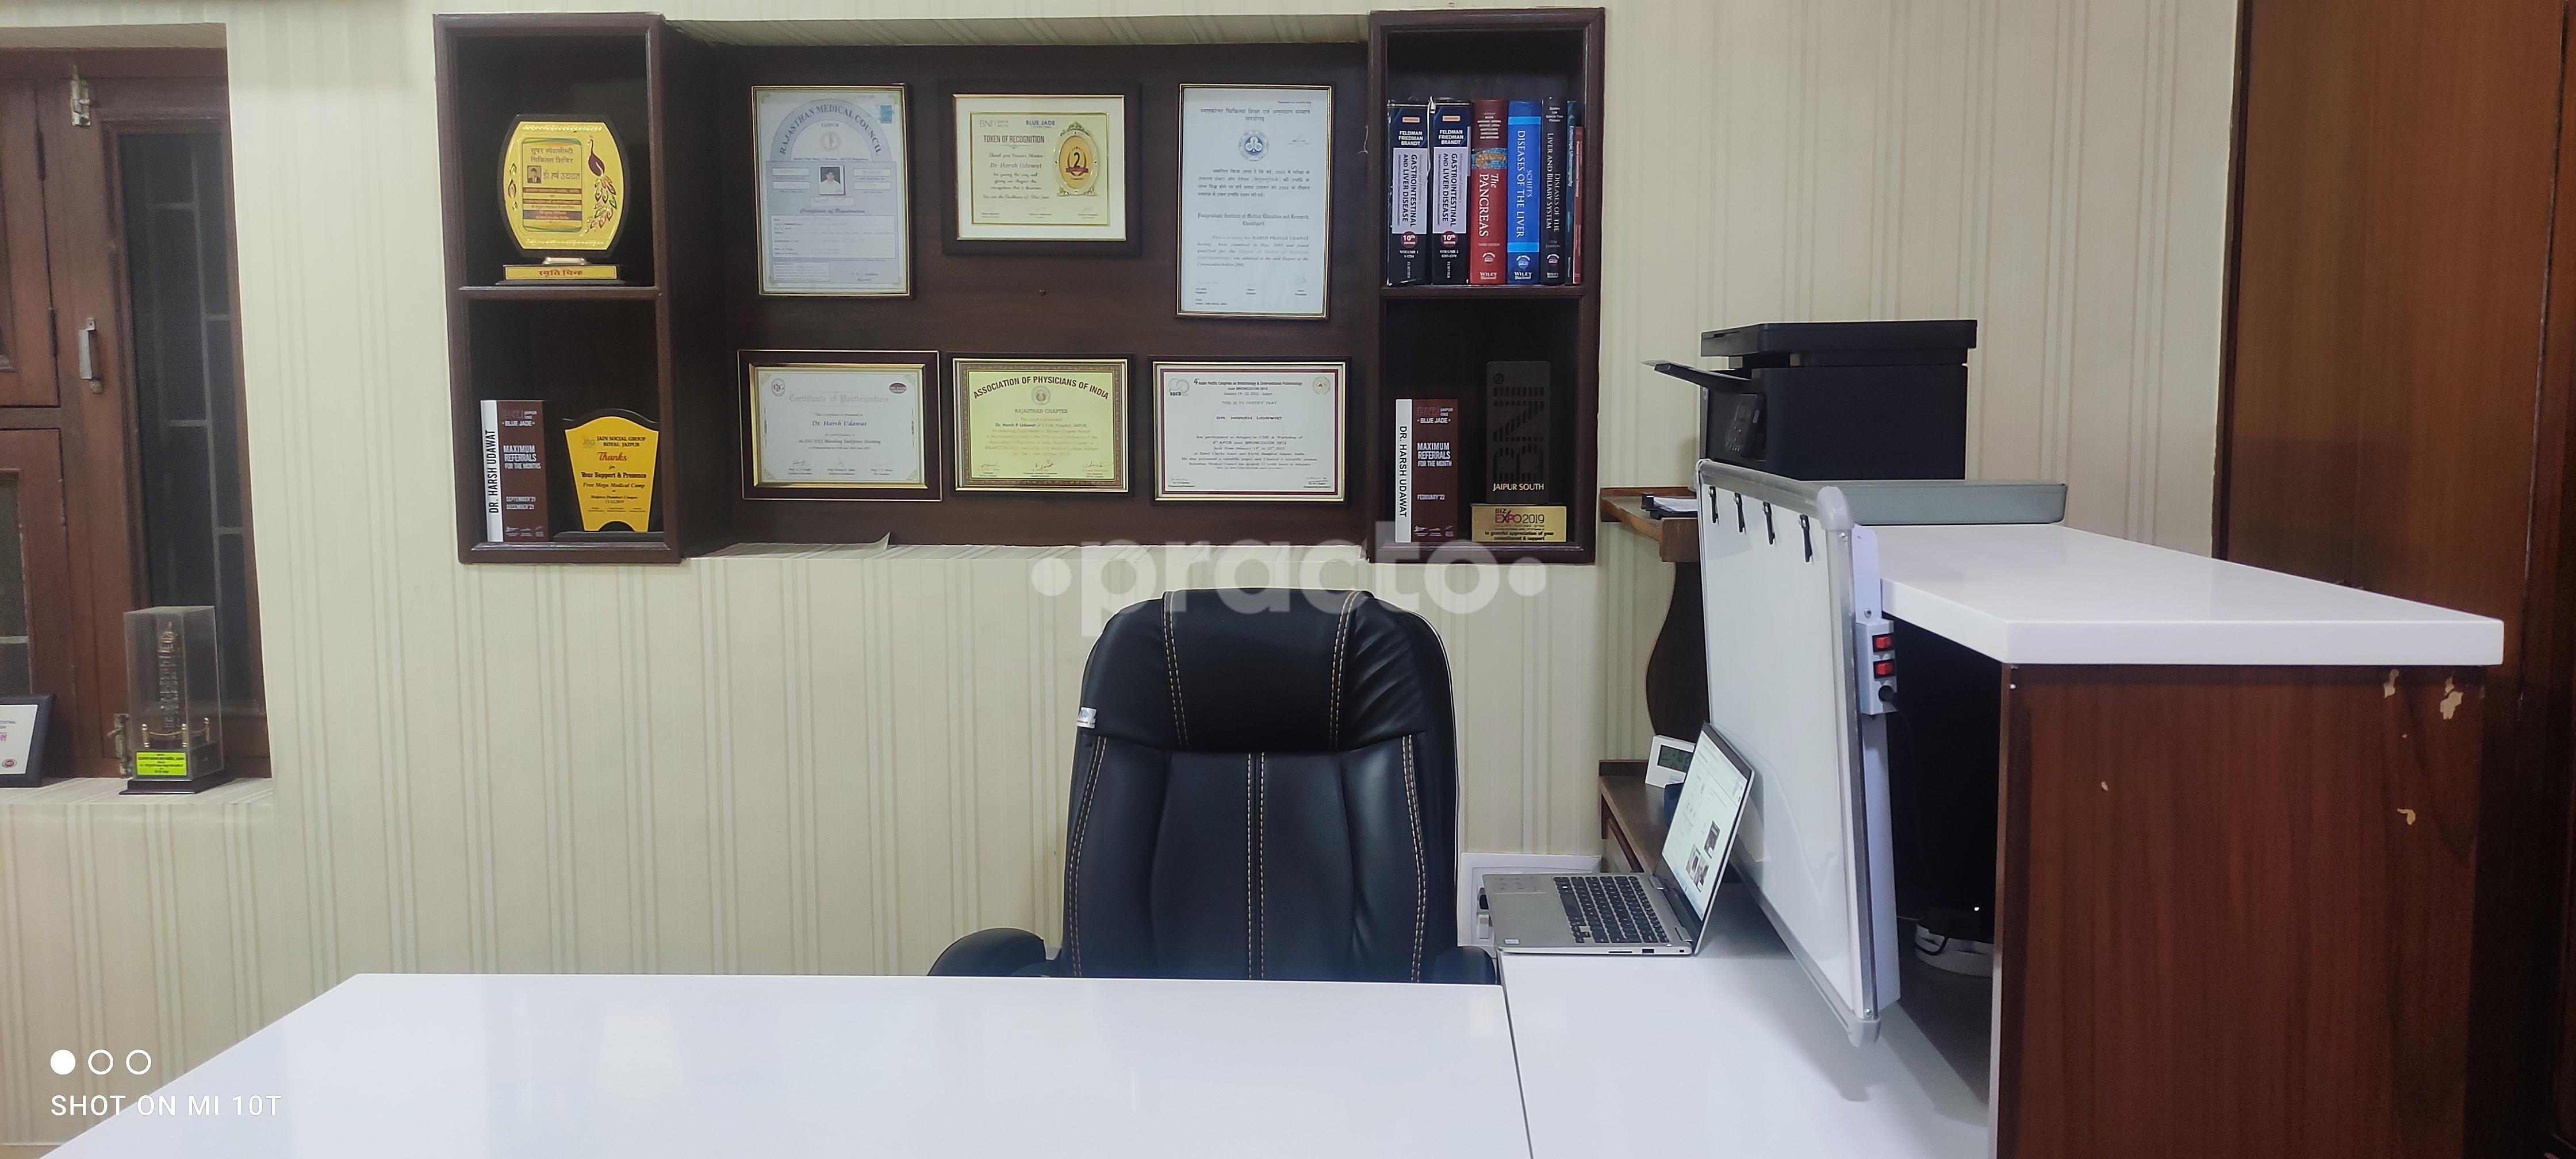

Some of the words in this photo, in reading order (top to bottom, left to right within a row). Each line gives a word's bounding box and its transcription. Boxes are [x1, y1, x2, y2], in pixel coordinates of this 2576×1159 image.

[779, 106, 815, 155] RAJASTHAN
[816, 104, 854, 118] MEDICAL
[854, 114, 882, 154] COUNCIL
[983, 135, 1001, 143] TOKEN
[1002, 135, 1009, 143] OF
[1517, 131, 1525, 171] DISEASES
[1074, 152, 1080, 168] 2
[551, 170, 559, 179] हर्ष
[1517, 174, 1525, 187] OF
[1490, 174, 1499, 189] The
[1478, 174, 1489, 237] PANCREAS
[1516, 190, 1524, 208] THE
[1554, 206, 1560, 216] OF
[1516, 212, 1524, 238] LIVER
[539, 269, 561, 277] स्मृति
[562, 268, 584, 277] चिन्ह
[973, 377, 1020, 399] ASSOCIATION
[1022, 376, 1032, 384] OF
[1033, 376, 1077, 387] PHYSICIANS
[1079, 381, 1088, 390] OF
[1089, 385, 1109, 400] INDIA
[788, 394, 826, 402] Certificate
[839, 394, 888, 404] Participation
[485, 429, 497, 466] UDAWAT
[503, 445, 535, 453] MAXIMUM
[1417, 442, 1450, 450] MAXIMUM
[504, 454, 536, 462] REFERRALS
[597, 451, 627, 461] Thanks
[1418, 451, 1451, 459] REFERRALS
[487, 468, 499, 496] HARSH
[1493, 483, 1517, 491] JAIPUR
[1399, 479, 1407, 517] UDAWAT
[489, 500, 499, 513] DR.
[1495, 510, 1522, 524] EXPO
[1522, 514, 1544, 524] 2019
